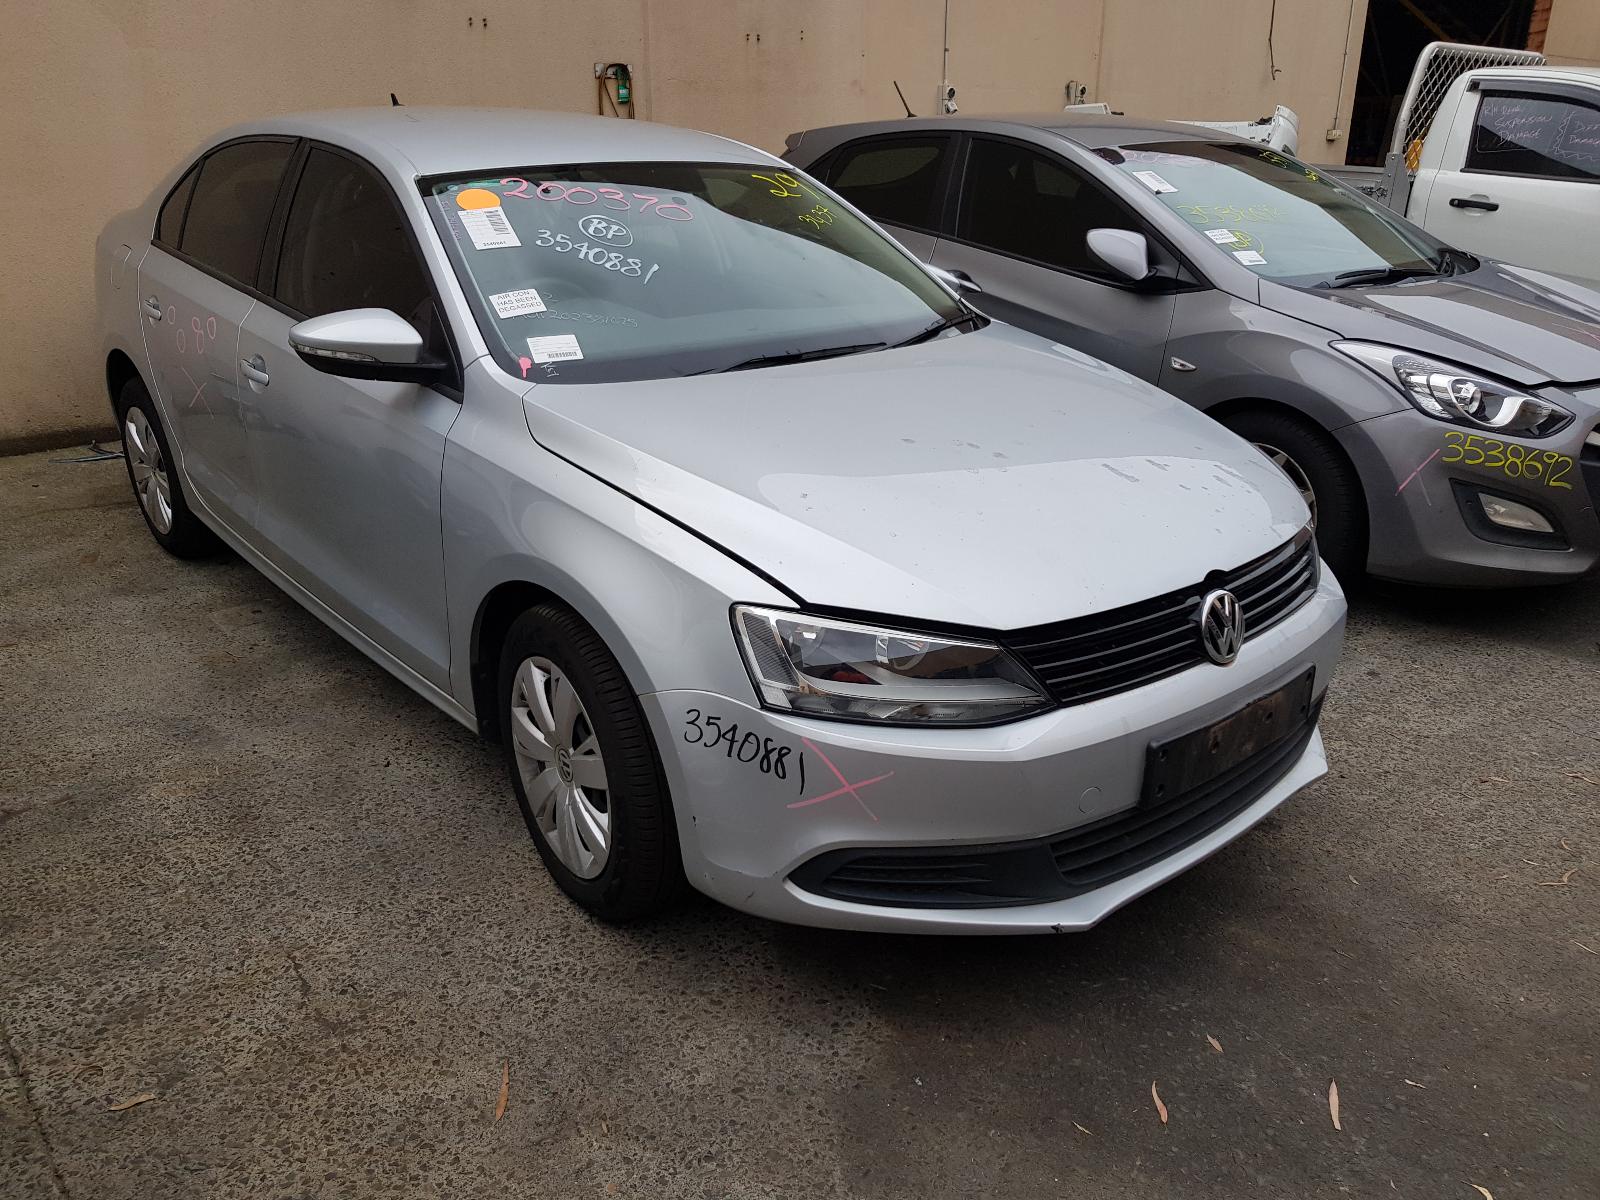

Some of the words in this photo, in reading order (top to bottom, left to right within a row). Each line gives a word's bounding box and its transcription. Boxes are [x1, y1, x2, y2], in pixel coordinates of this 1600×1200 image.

[500, 177, 696, 221] 200370
[535, 229, 661, 285] 3540881
[497, 292, 512, 301] AIR
[512, 290, 531, 299] CON
[497, 298, 516, 307] HAS
[515, 295, 538, 304] BEEN
[498, 301, 543, 313] DEGASSED
[1442, 431, 1574, 490] 3538692
[684, 708, 805, 795] 3540881
